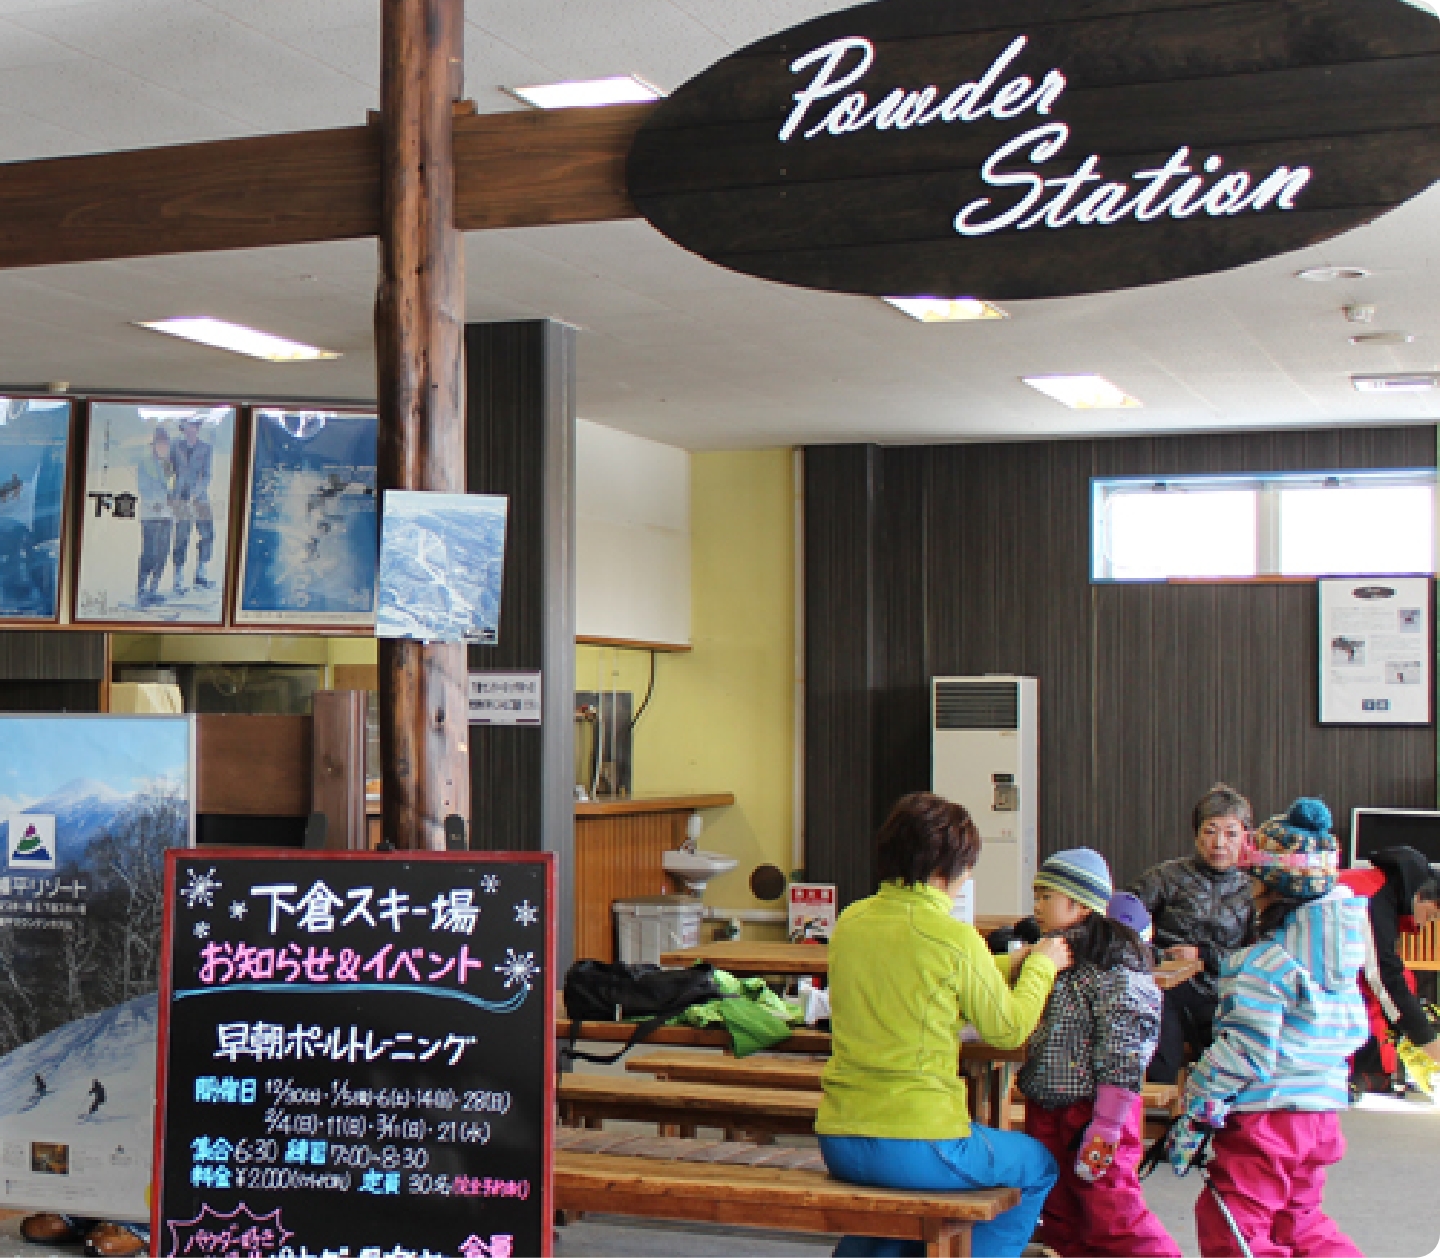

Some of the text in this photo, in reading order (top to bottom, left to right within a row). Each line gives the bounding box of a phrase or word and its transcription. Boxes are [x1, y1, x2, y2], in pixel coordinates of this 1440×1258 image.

[778, 35, 1068, 141] Powder
[953, 122, 1312, 235] Station
[250, 879, 481, 935] 下倉スキー場
[198, 941, 484, 984] お知らせ&イベント
[212, 1020, 478, 1065] 早朝ポールトレーニング
[193, 1075, 257, 1102] 開催日
